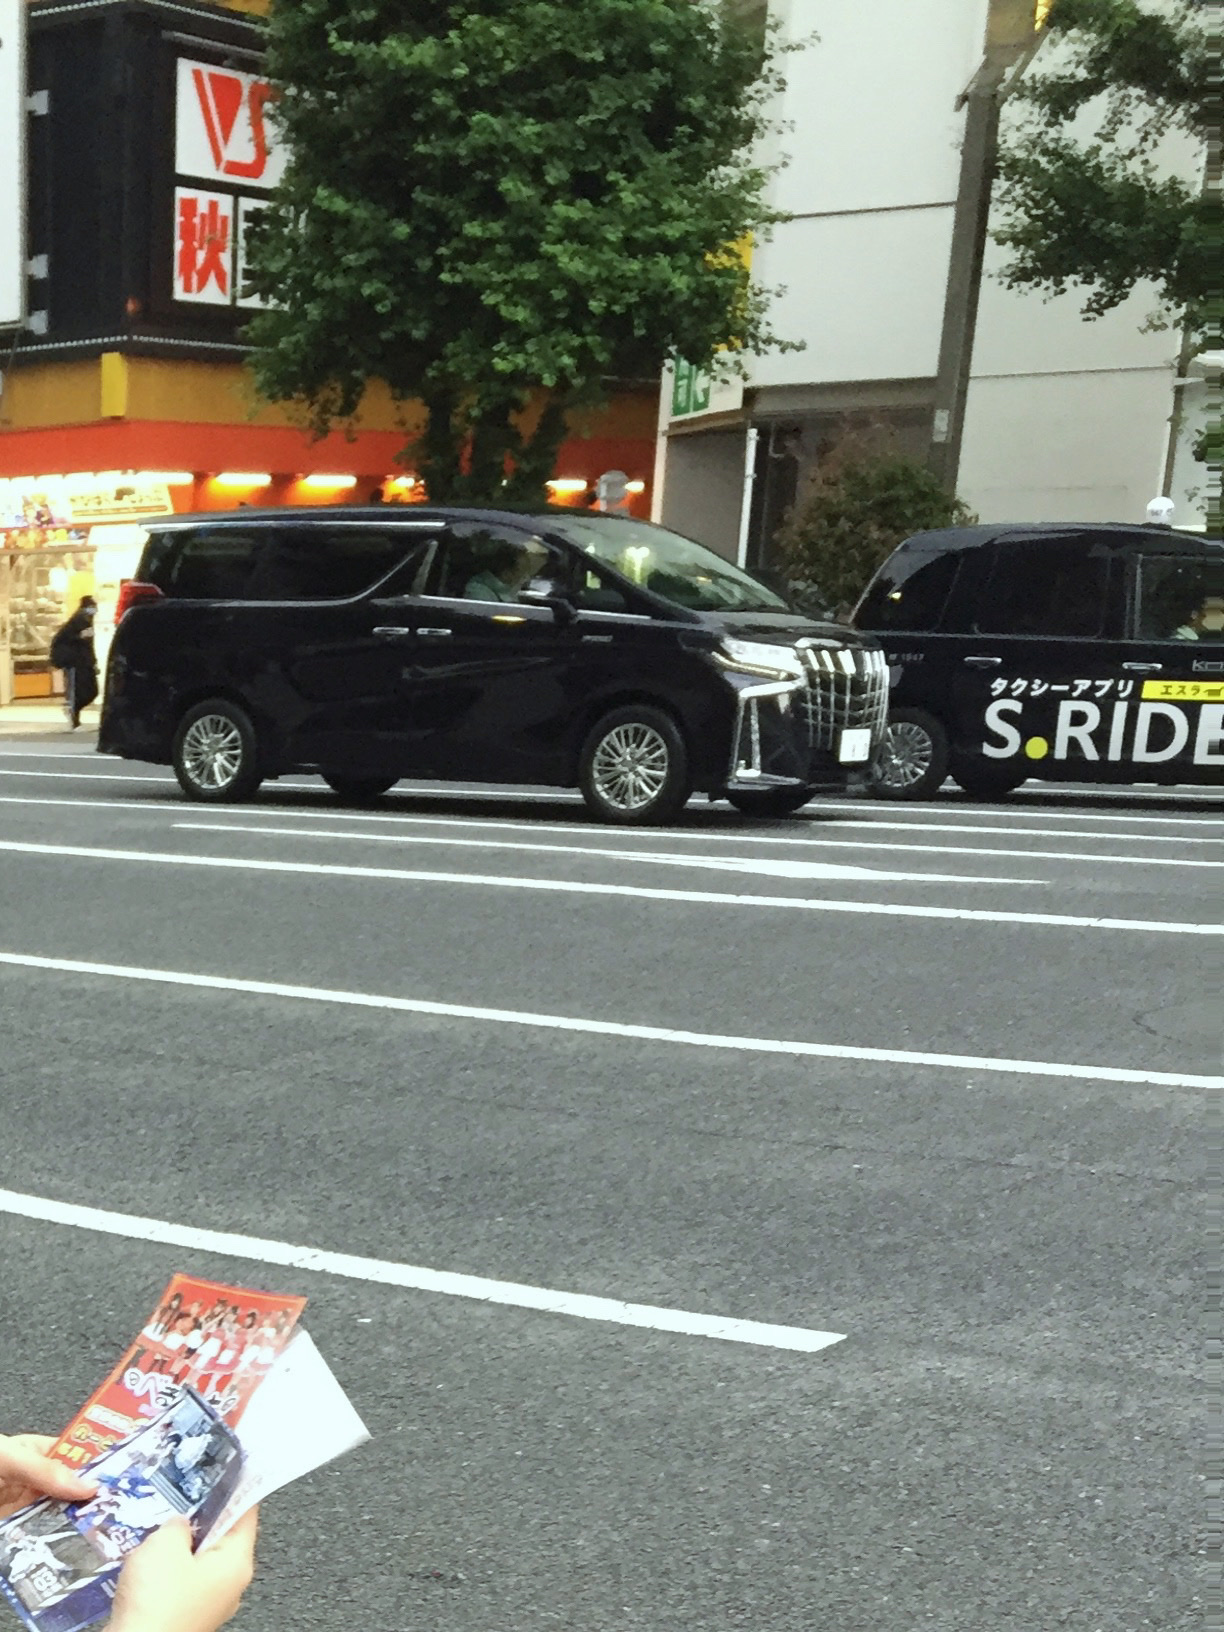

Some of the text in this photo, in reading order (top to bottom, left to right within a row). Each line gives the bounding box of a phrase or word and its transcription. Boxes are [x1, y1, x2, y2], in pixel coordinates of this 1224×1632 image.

[990, 677, 1135, 698] タクシーアプリ
